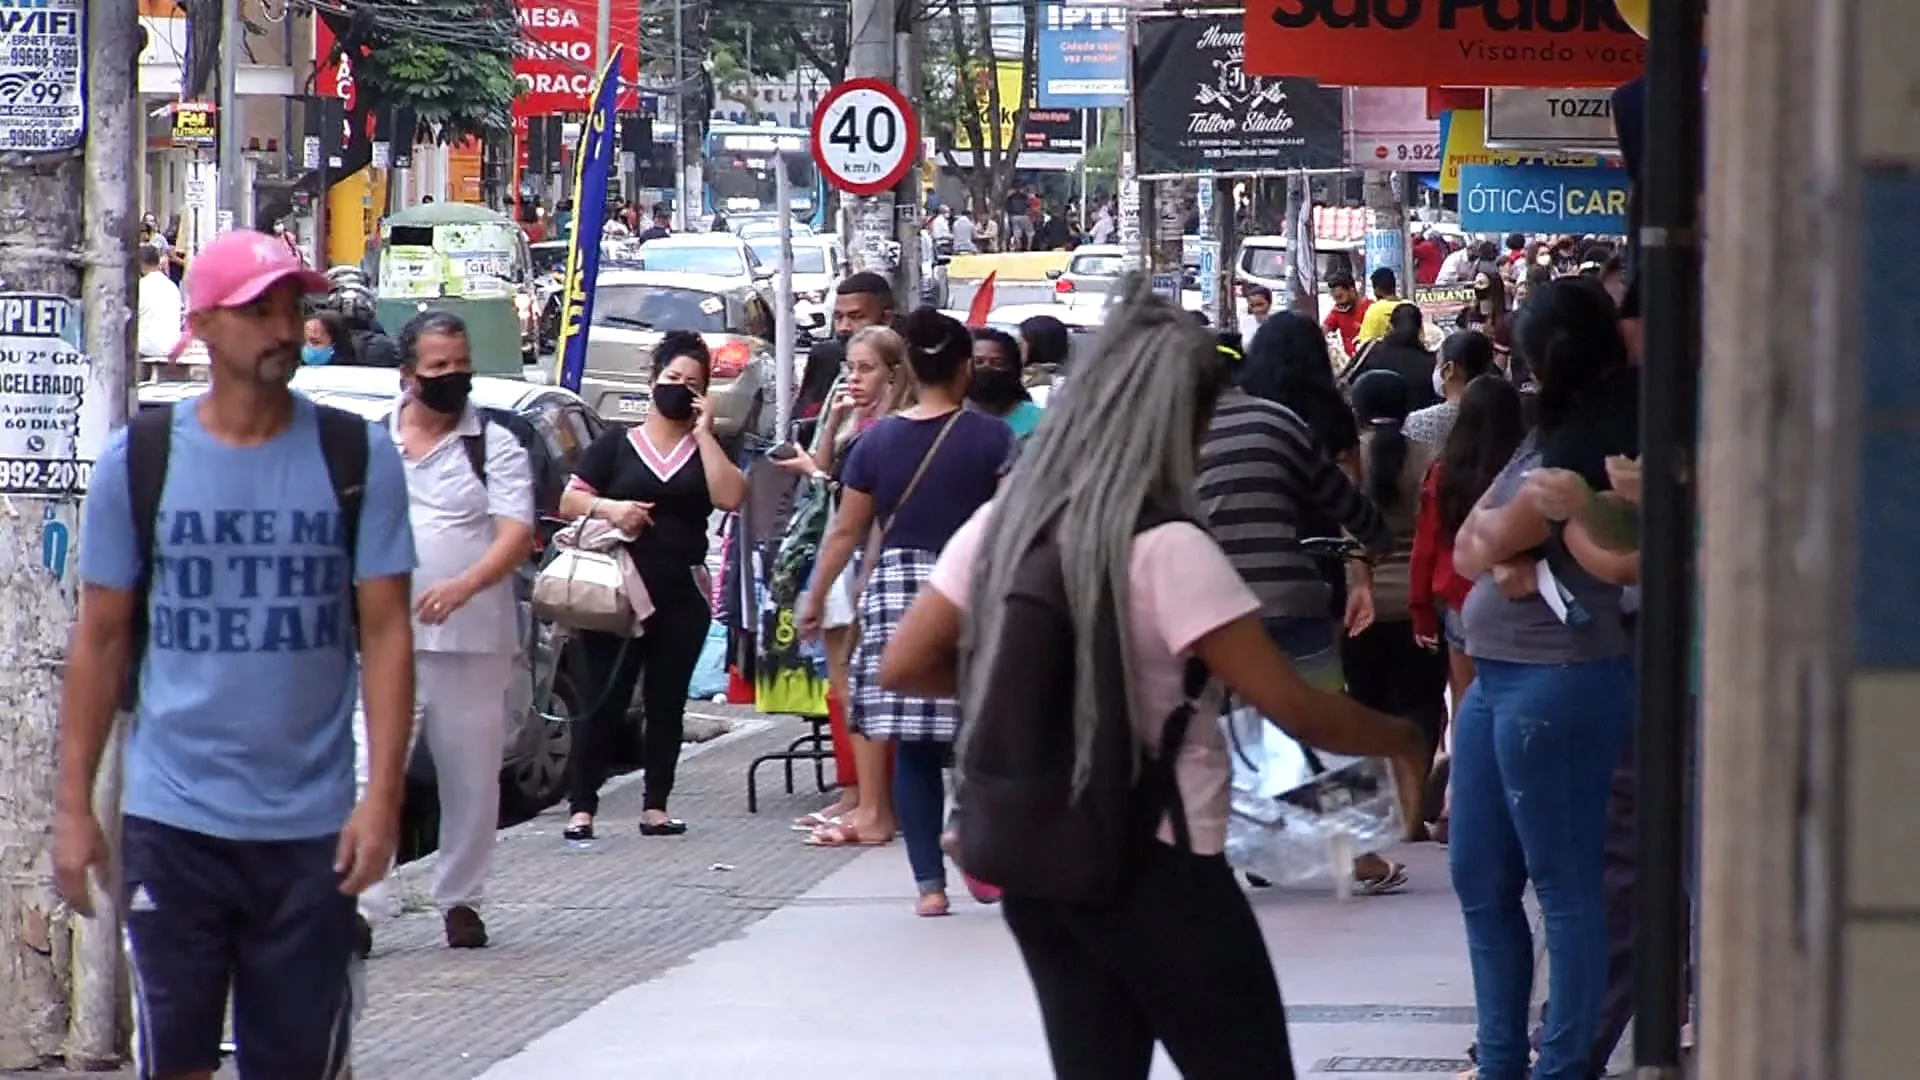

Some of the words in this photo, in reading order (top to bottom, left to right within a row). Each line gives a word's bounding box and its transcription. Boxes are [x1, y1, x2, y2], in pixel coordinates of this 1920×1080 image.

[1459, 40, 1573, 62] Visando
[32, 83, 61, 104] 99
[1547, 99, 1611, 119] TOZZI
[829, 105, 897, 154] 40
[1188, 111, 1236, 134] Tattoo
[1241, 108, 1294, 133] Studio
[843, 160, 881, 174] km/h
[14, 404, 53, 416] partir
[5, 418, 26, 430] 60
[31, 418, 67, 430] DIAS
[160, 510, 277, 545] AKE
